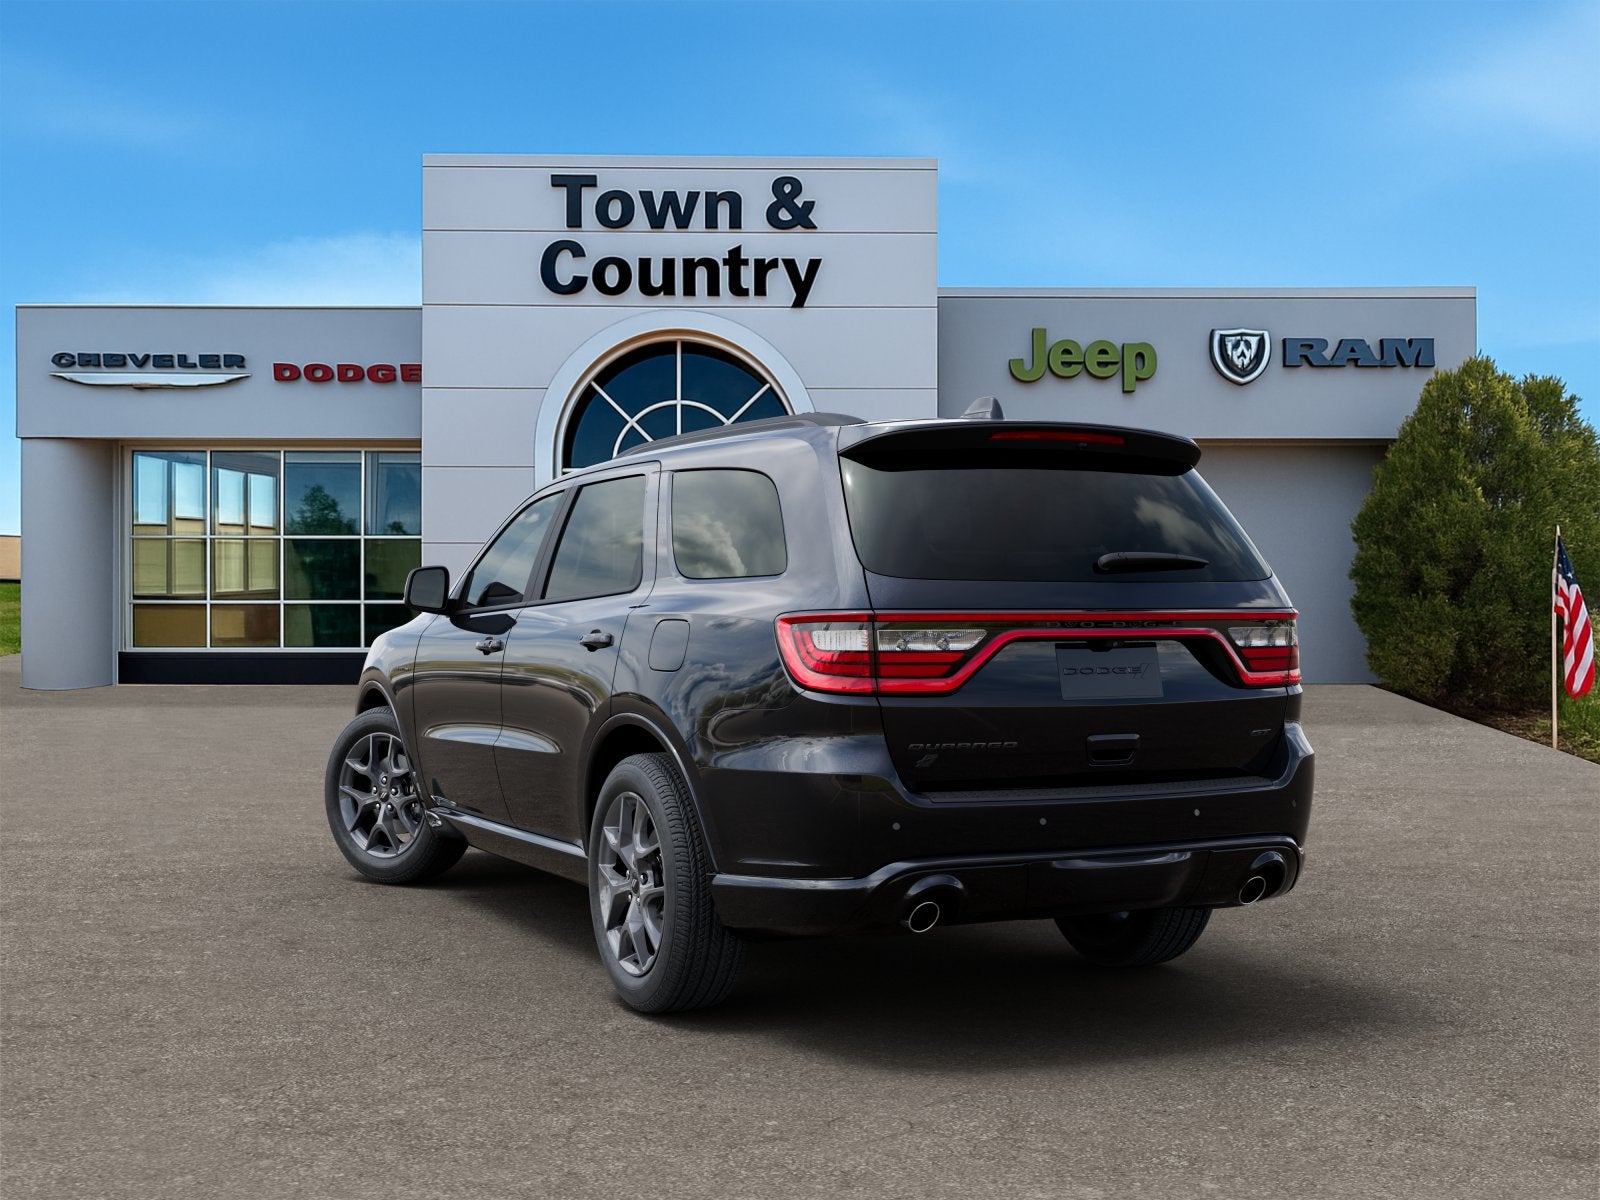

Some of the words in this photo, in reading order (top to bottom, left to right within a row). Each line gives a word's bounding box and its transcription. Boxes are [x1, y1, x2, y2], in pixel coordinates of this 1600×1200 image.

[551, 174, 742, 229] Town
[766, 176, 817, 229] &
[540, 239, 822, 308] Country
[273, 362, 422, 384] DODGE
[1009, 328, 1157, 393] Jeep
[1283, 338, 1435, 368] RAM
